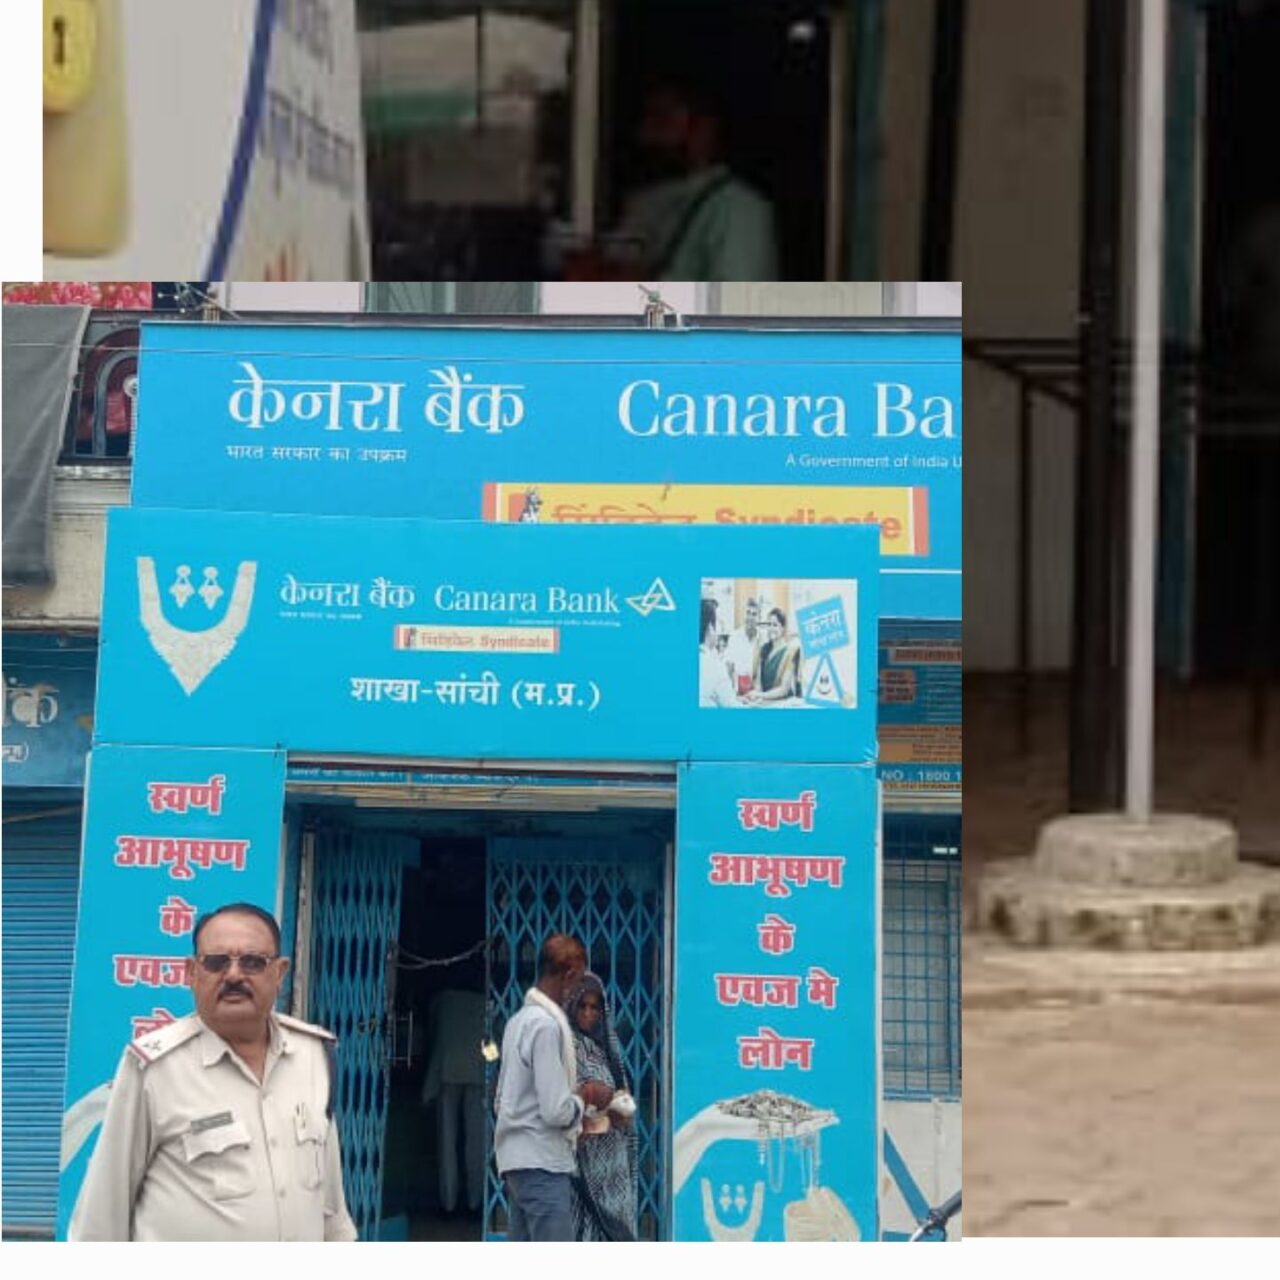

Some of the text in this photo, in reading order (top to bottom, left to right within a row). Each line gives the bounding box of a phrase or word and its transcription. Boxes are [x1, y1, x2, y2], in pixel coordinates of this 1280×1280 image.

[227, 361, 526, 434] केनरा बैंक
[617, 378, 957, 439] Canara Ba
[226, 445, 407, 464] भारत सरकार का उपक्रम
[785, 453, 797, 467] A
[800, 453, 889, 469] Government
[893, 453, 909, 469] of
[911, 455, 949, 469] India
[280, 573, 418, 610] केनरा बैंक
[434, 584, 621, 615] Canara Bank
[479, 633, 550, 651] Syndicate
[350, 669, 602, 711] शाखा-सांची (म.प्र.)
[148, 774, 226, 816] स्वर्ण
[738, 791, 816, 832] स्वर्ण
[115, 834, 251, 880] आभूषण
[709, 853, 845, 897] आभूषण
[160, 895, 197, 937] के
[758, 913, 795, 955] के
[715, 966, 839, 1009] एवज मे
[737, 1026, 815, 1071] लोन
